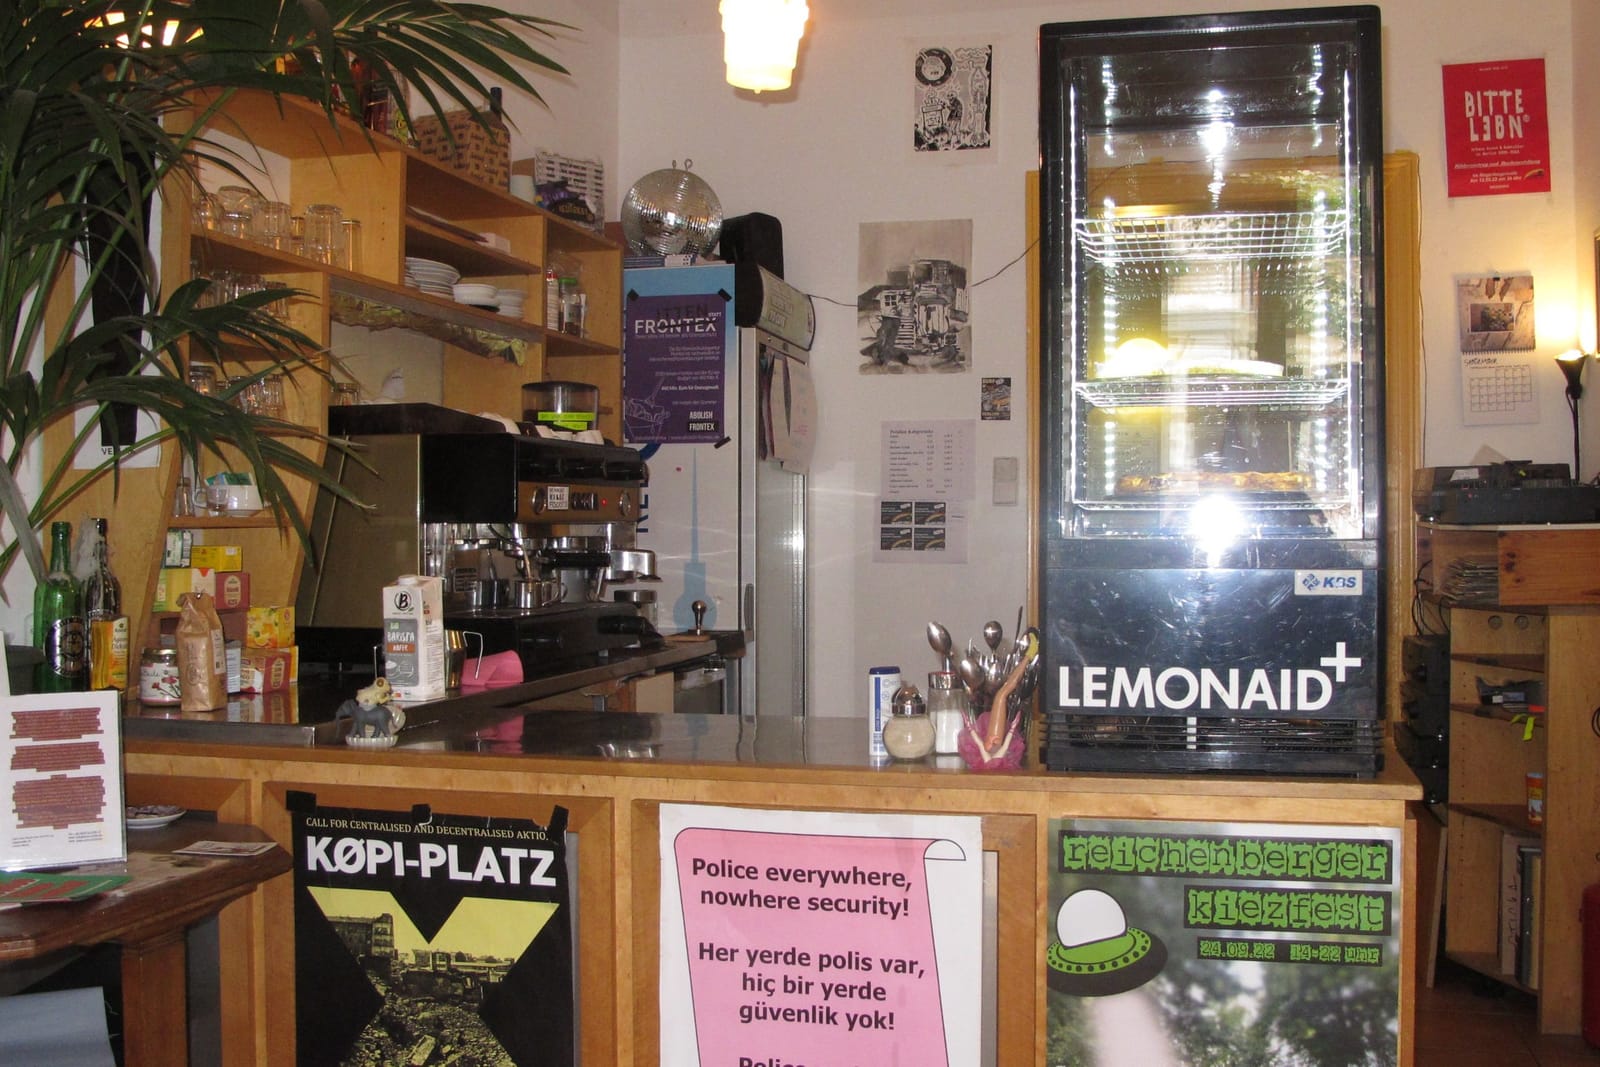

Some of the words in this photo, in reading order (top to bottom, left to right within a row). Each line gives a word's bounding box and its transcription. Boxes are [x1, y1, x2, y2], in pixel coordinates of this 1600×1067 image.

[1465, 89, 1523, 118] BITTE
[634, 317, 717, 334] FRONTEX
[688, 411, 714, 420] ABOLISH
[688, 422, 716, 432] FRONTEX
[387, 631, 415, 643] BARISTA
[306, 816, 328, 830] CALL
[330, 819, 348, 831] FOR
[349, 821, 412, 834] CENTRALISED
[413, 824, 435, 836] AND
[436, 826, 514, 840] DECENTRALISED
[307, 836, 557, 886] KØPI-PLATZ
[1065, 835, 1388, 877] reichenberger
[692, 857, 758, 880] Police
[766, 866, 911, 892] everywhere,
[700, 889, 801, 911] nowhere
[807, 894, 910, 920] security!
[1187, 890, 1386, 930] kiezfest
[698, 942, 739, 963] Her
[746, 946, 811, 968] yerde
[818, 950, 873, 973] polis
[879, 957, 925, 979] var,
[1199, 941, 1275, 959] 24.09.22
[741, 973, 776, 997] hiç
[783, 976, 814, 996] bir
[820, 981, 887, 1002] yerde
[739, 1001, 839, 1027] güvenlik
[845, 1011, 895, 1032] yok!
